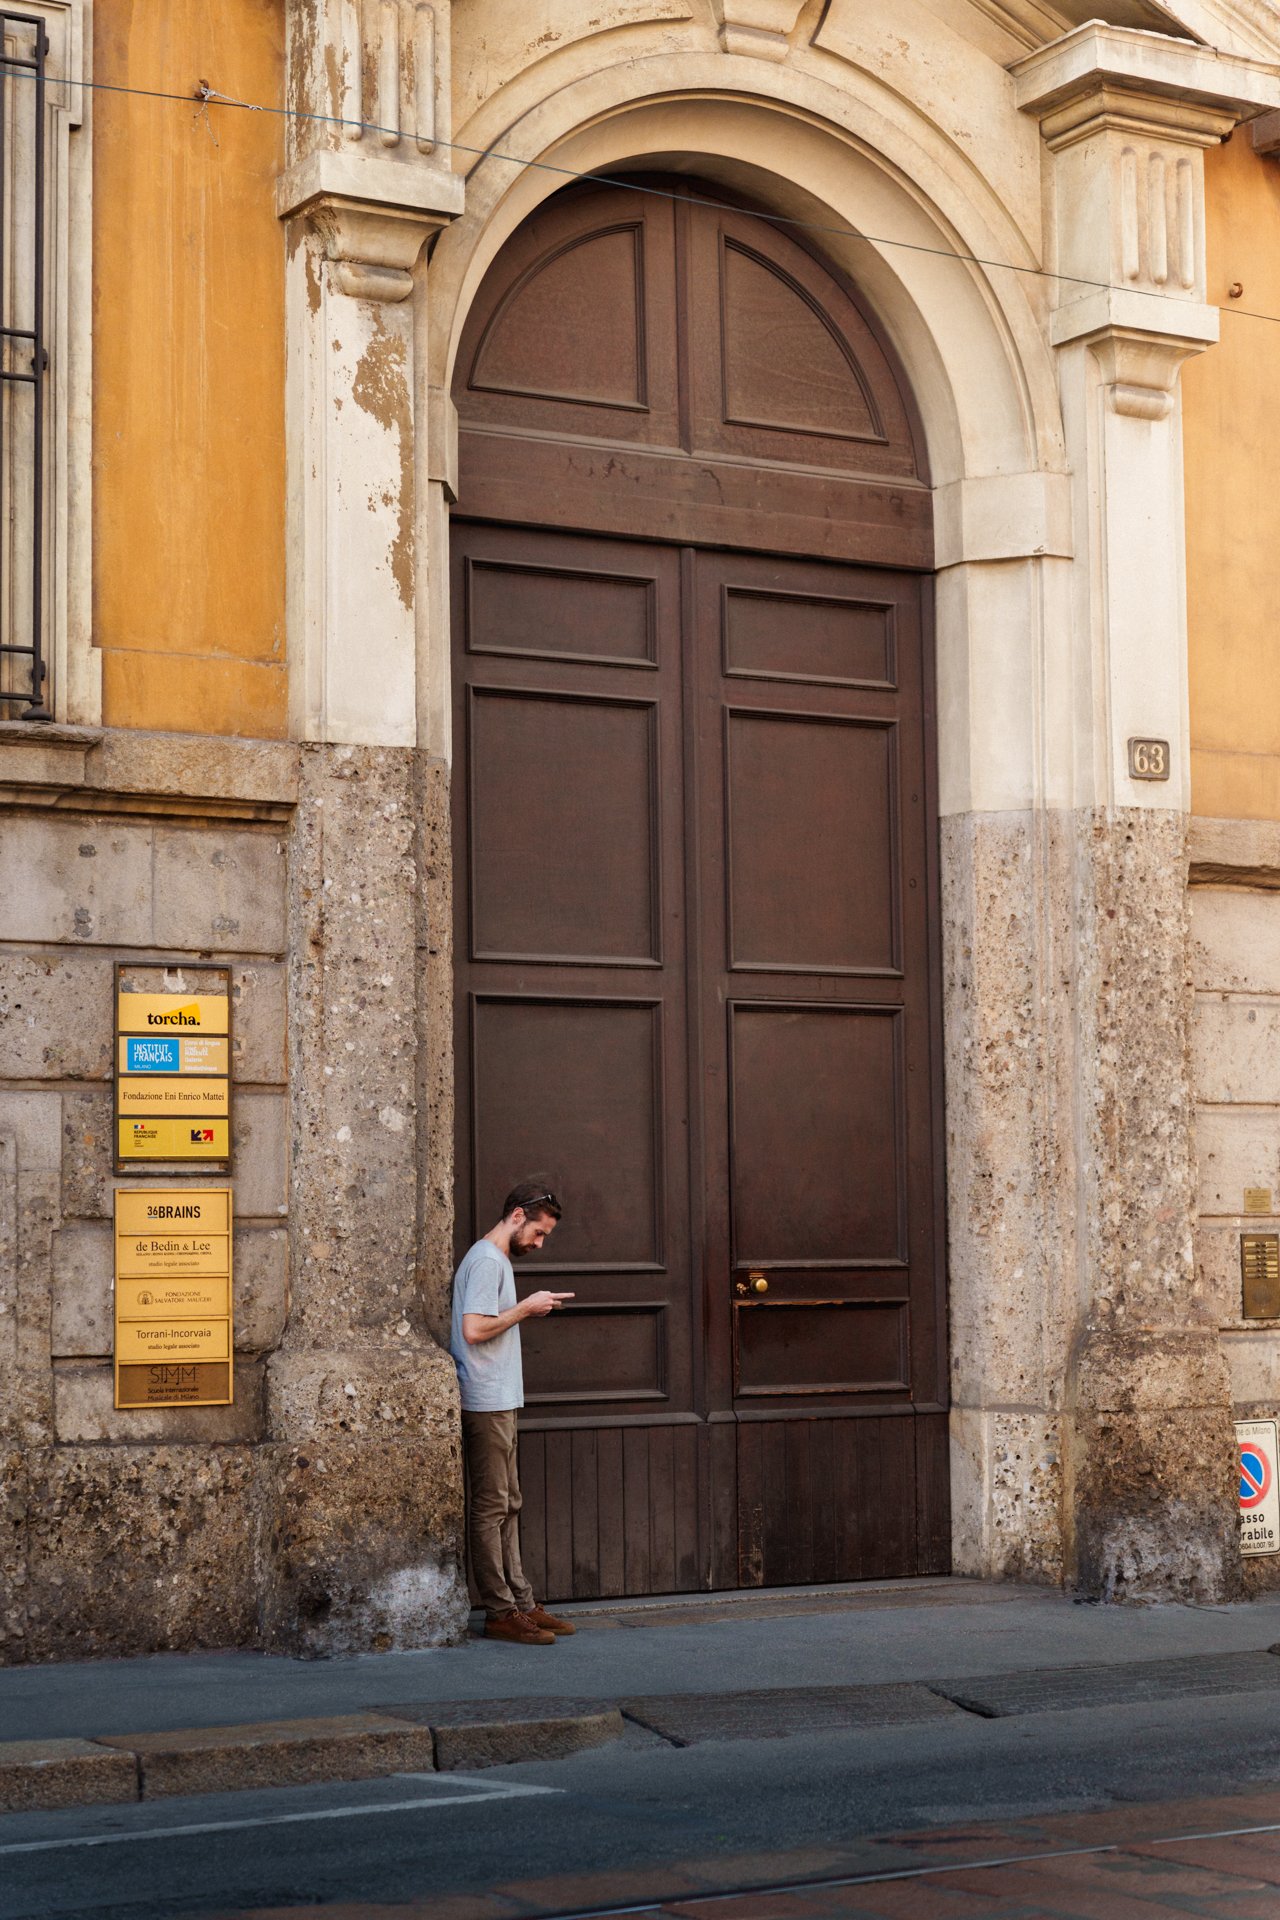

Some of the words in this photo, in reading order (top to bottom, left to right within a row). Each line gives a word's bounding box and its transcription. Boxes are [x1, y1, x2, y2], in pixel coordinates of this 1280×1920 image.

[1134, 743, 1165, 774] 63
[147, 1011, 201, 1026] torcha.
[133, 1043, 169, 1054] INSTITUT
[123, 1091, 163, 1101] Fondazione
[164, 1092, 177, 1101] Eni
[178, 1092, 201, 1101] Enrico
[202, 1092, 225, 1101] Mattei
[147, 1205, 201, 1219] 36BRAINS
[135, 1241, 148, 1252] de
[151, 1240, 180, 1252] Bedin
[182, 1242, 189, 1251] &
[192, 1240, 211, 1251] Lee
[136, 1328, 212, 1339] Torrani-Incorvaia
[150, 1366, 196, 1385] SIMM
[1252, 1427, 1272, 1435] Milano
[1240, 1513, 1265, 1523] asso
[1241, 1527, 1274, 1540] rabile
